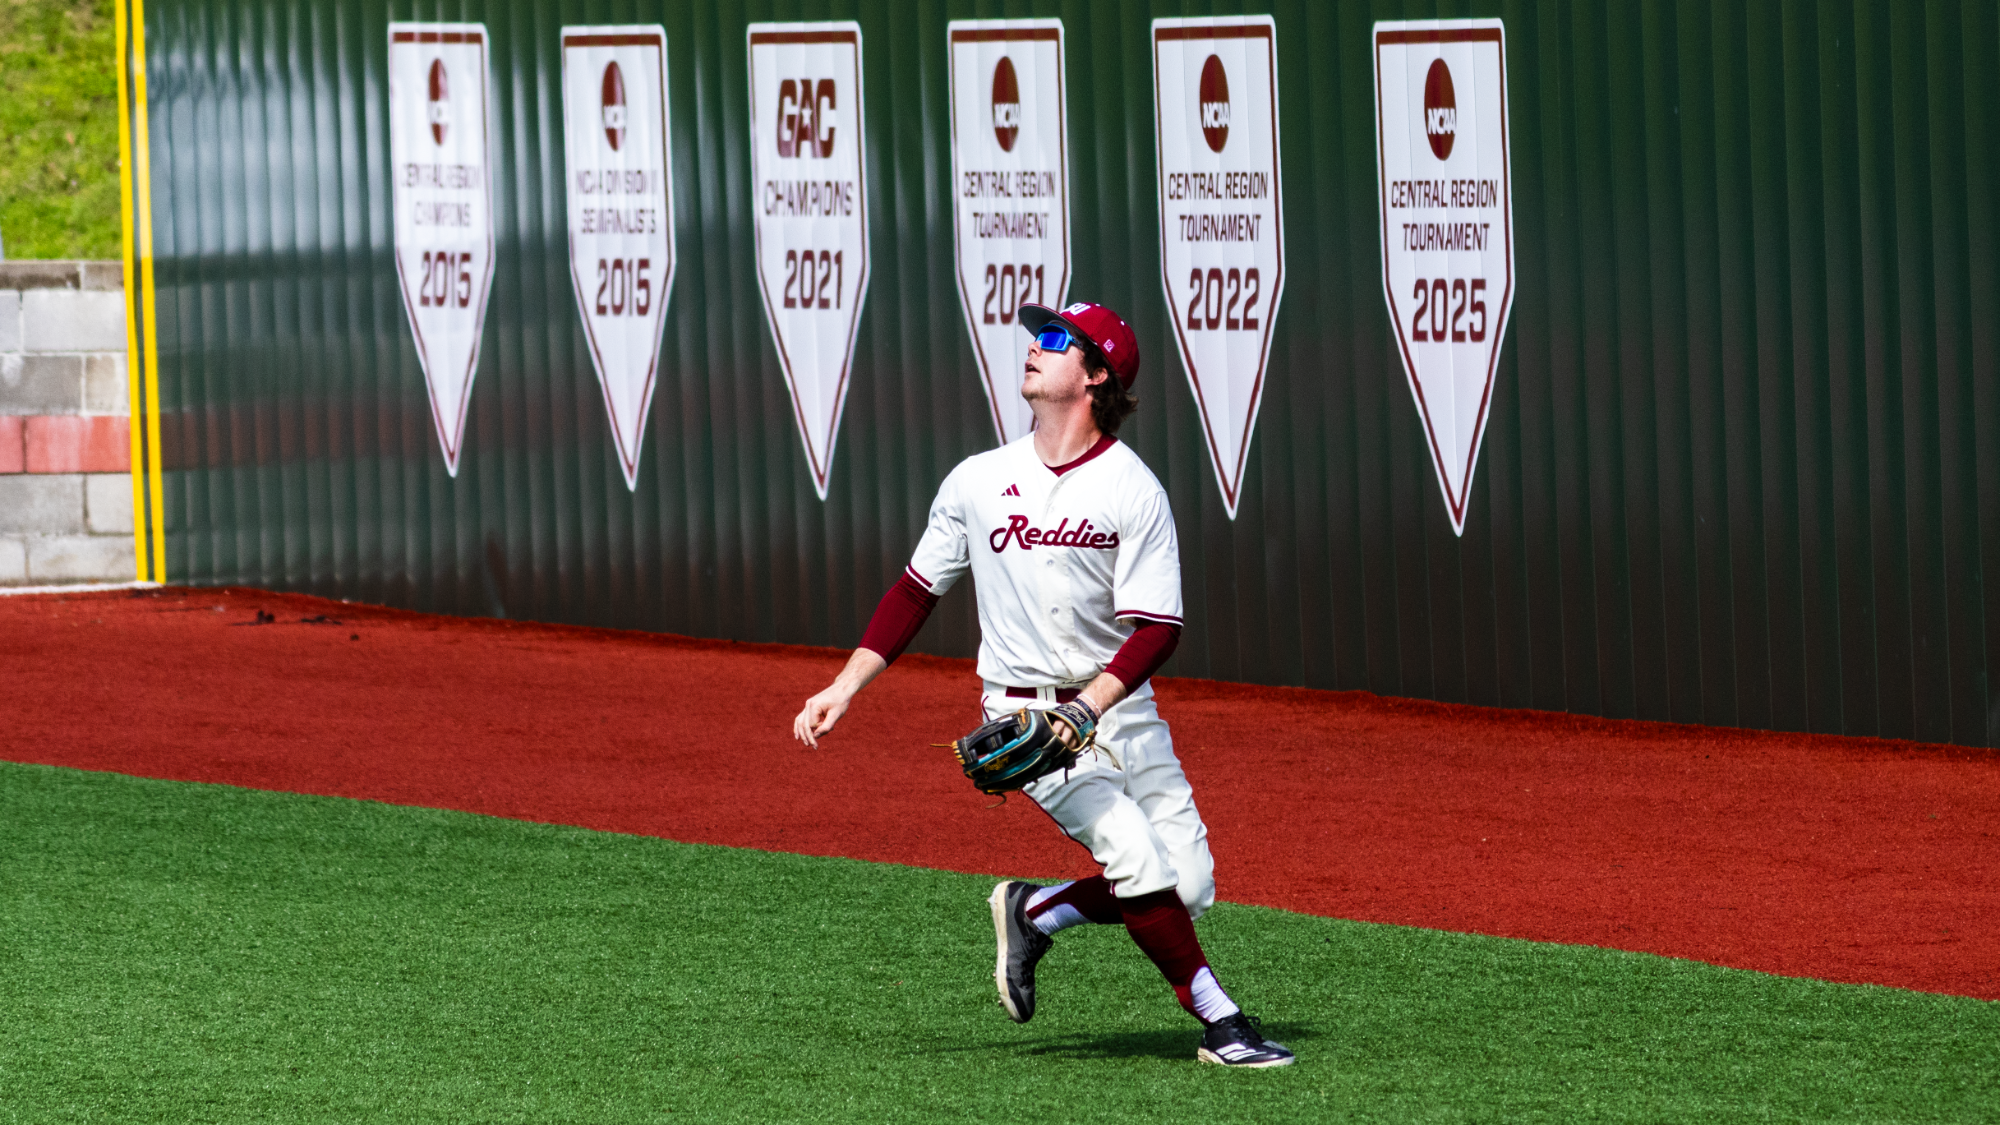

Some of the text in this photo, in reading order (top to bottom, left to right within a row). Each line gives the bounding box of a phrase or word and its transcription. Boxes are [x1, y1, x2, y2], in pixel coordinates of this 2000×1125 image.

[777, 78, 836, 159] GAC
[1202, 102, 1230, 128] NCAA
[1428, 108, 1456, 135] NCAA
[764, 180, 853, 217] CHAMPIONS
[963, 171, 1055, 198] CENTRAL REGION
[1168, 171, 1268, 201] CENTRAL REGION
[1391, 179, 1498, 209] CENTRAL REGION
[972, 211, 1049, 239] TOURNAMENT
[1179, 214, 1262, 243] TOURNAMENT
[1402, 223, 1490, 252] TOURNAMENT
[420, 251, 471, 308] 2015
[596, 258, 650, 316] 2015
[783, 249, 843, 310] 2021
[983, 263, 1045, 325] 2021
[1187, 267, 1260, 331] 2022
[1412, 278, 1487, 343] 2025
[989, 514, 1120, 554] Reddies
